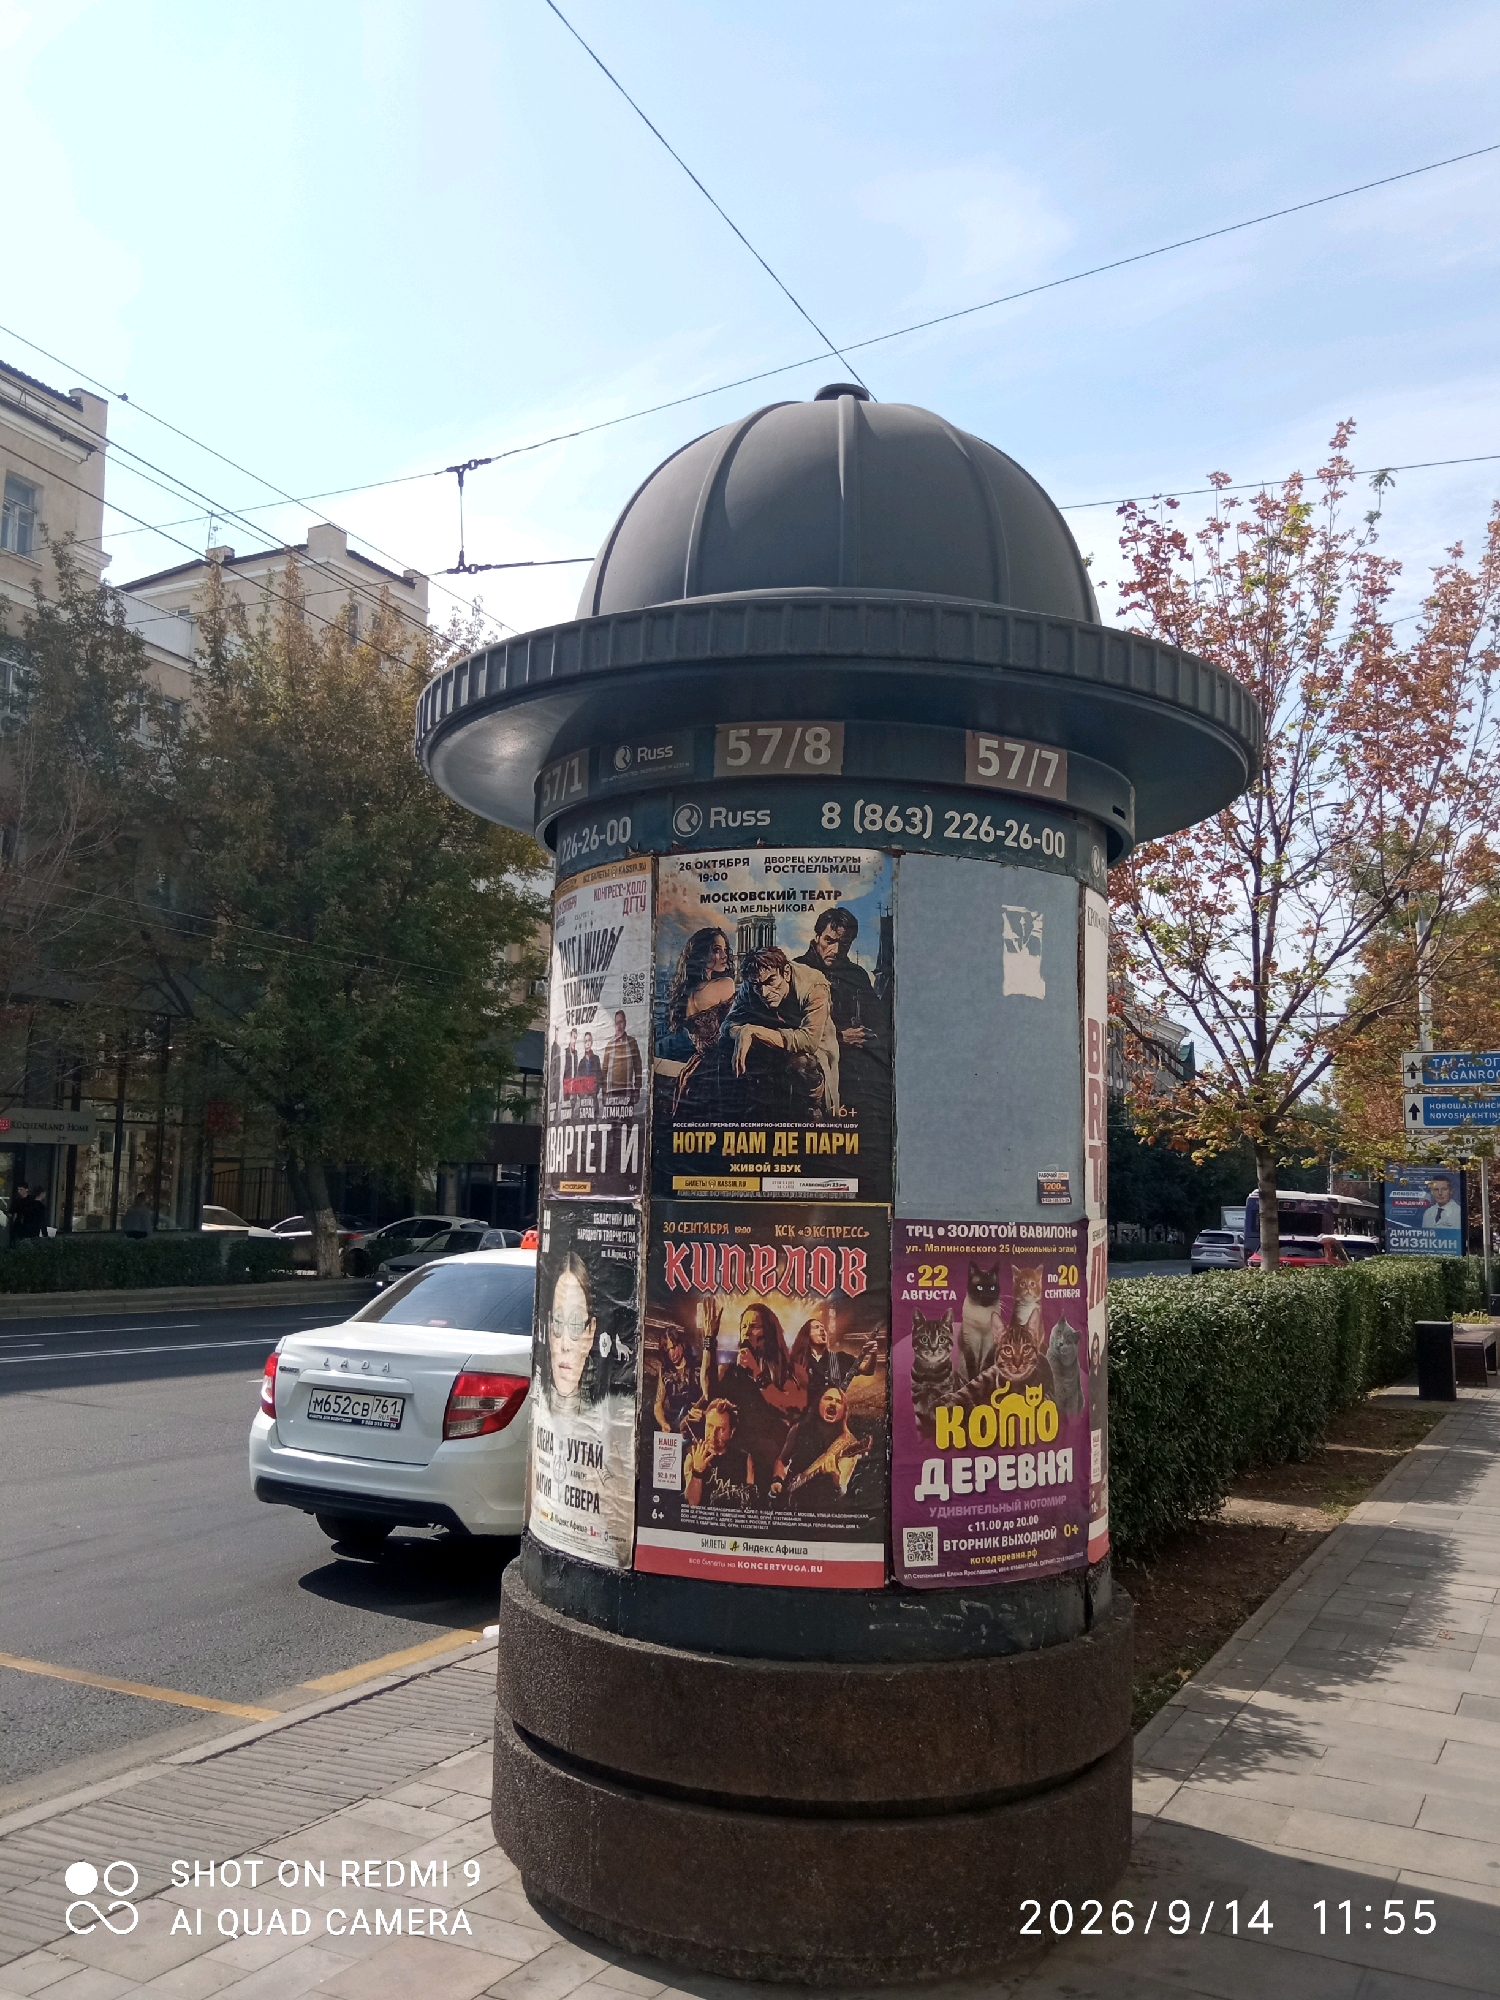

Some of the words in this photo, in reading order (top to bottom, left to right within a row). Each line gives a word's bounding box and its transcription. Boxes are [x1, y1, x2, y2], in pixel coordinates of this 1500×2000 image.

[637, 745, 673, 763] Russ
[726, 726, 831, 768] 57/8
[977, 739, 1057, 788] 57/7
[543, 757, 582, 807] 57/1
[710, 805, 770, 828] Russ
[821, 801, 840, 828] 8
[854, 798, 933, 840] (863)
[945, 810, 1065, 858] 226-26-00
[679, 862, 692, 872] 26
[695, 857, 750, 870] ОКТЯБРЯ
[764, 856, 806, 865] ДВОРЕЦ
[808, 855, 861, 865] КУЛЬТУРЫ
[764, 864, 861, 874] РОСТСЕЛЬМАШ
[698, 872, 728, 883] 19:00
[700, 888, 796, 904] МОСКОВСКИЙ
[800, 890, 842, 901] ТЕАТР
[723, 906, 738, 915] НА
[741, 903, 815, 914] МЕЛЬНИКОВА
[602, 1106, 634, 1119] ДЕМИДОВ
[830, 1106, 858, 1118] 16+
[620, 1124, 639, 1174] И
[673, 1131, 717, 1154] НОТР
[722, 1131, 766, 1156] ДАМ
[773, 1131, 799, 1156] ДЕ
[805, 1132, 859, 1155] ПАРИ
[730, 1162, 771, 1173] ЖИВОЙ
[773, 1164, 801, 1173] ЗВУК
[663, 1222, 675, 1233] 30
[678, 1222, 729, 1234] СЕНТЯБРЯ
[775, 1225, 795, 1237] КСК
[798, 1225, 869, 1238] «ЭКСПРЕСС»
[906, 1225, 933, 1239] ТРЦ
[1390, 1229, 1436, 1238] ДМИТРИЙ
[905, 1244, 922, 1254] ул.
[925, 1243, 996, 1253] Малиновского
[999, 1244, 1009, 1253] 25
[1390, 1238, 1457, 1249] СИЗЯКИН
[918, 1264, 948, 1287] 22
[1047, 1273, 1058, 1283] по
[1058, 1264, 1079, 1286] 20
[901, 1290, 957, 1300] АВГУСТА
[1045, 1288, 1081, 1299] СЕНТЯБРЯ
[374, 1398, 398, 1415] 761
[658, 1437, 678, 1447] НАШЕ
[567, 1438, 603, 1470] УУТАЙ
[914, 1447, 1073, 1501] ДЕРЕВНЯ
[565, 1484, 600, 1514] СЕВЕРА
[929, 1500, 1021, 1518] УДИВИТЕЛЬНЫЙ
[1024, 1496, 1066, 1510] КОТОМИР
[651, 1508, 665, 1519] 6+
[975, 1520, 1001, 1532] 11.00
[1002, 1520, 1015, 1531] до
[1016, 1515, 1039, 1528] 20.00
[1063, 1524, 1079, 1537] 0+
[943, 1536, 999, 1551] ВТОРНИК
[1002, 1526, 1057, 1547] ВЫХОДНОЙ
[701, 1538, 726, 1550] БИЛЕТЫ
[742, 1541, 774, 1554] Яндекс
[775, 1541, 808, 1556] Афиша
[970, 1549, 1038, 1565] котодеревня.рф
